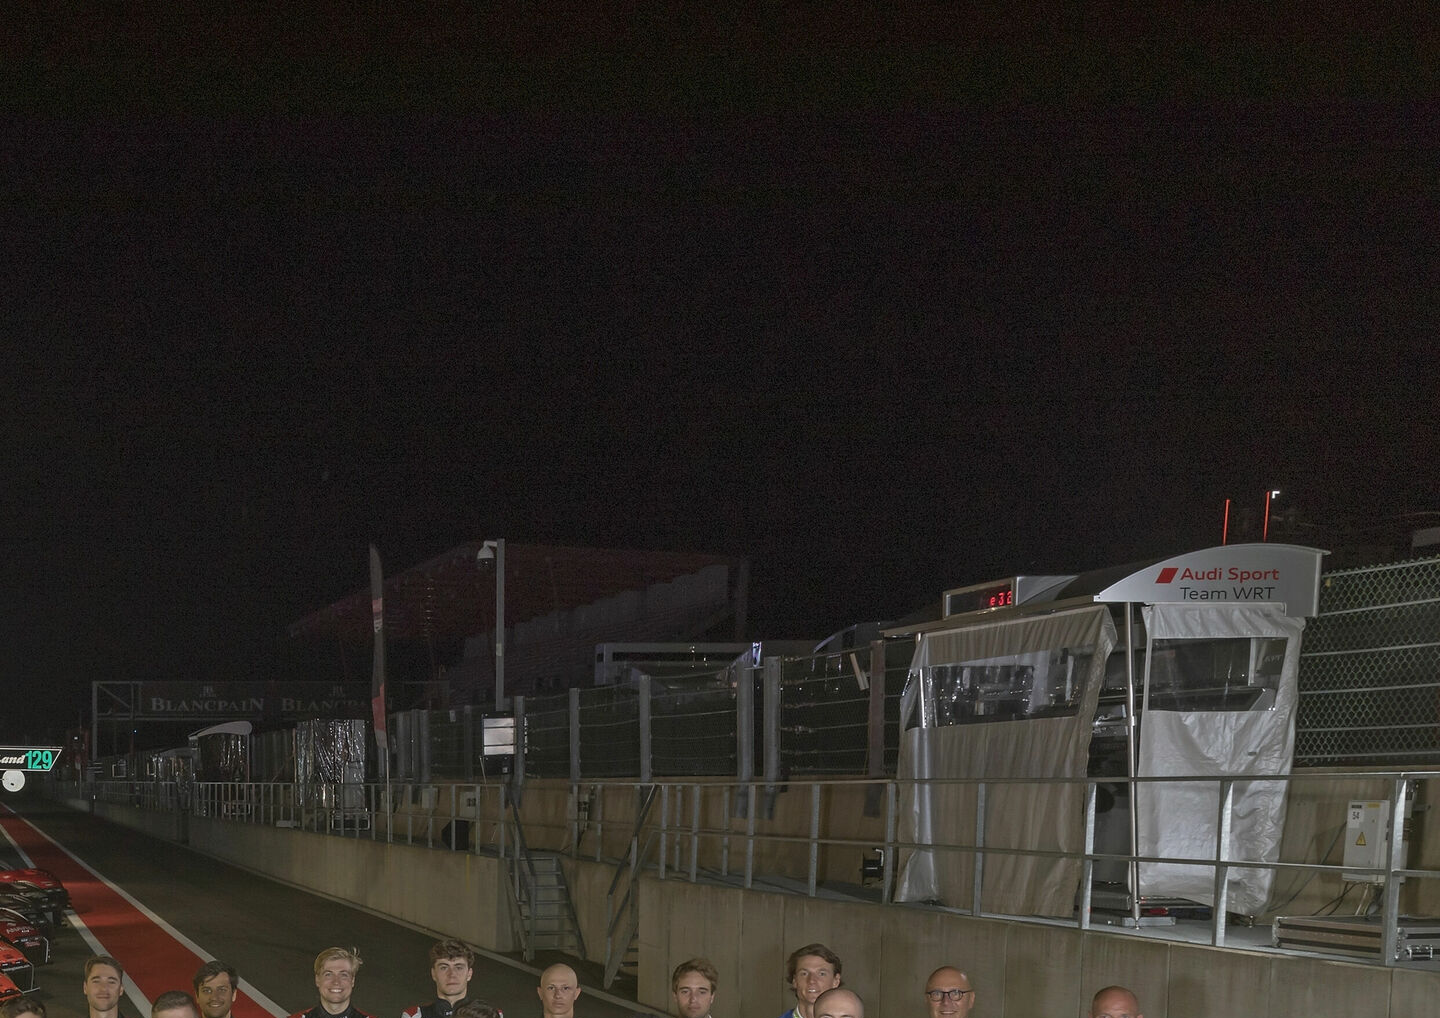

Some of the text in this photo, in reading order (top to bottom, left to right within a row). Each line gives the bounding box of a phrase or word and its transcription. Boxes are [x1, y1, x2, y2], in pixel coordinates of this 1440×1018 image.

[1180, 566, 1279, 584] Audi Sport
[1180, 586, 1276, 601] Team WRT
[25, 751, 53, 770] 129
